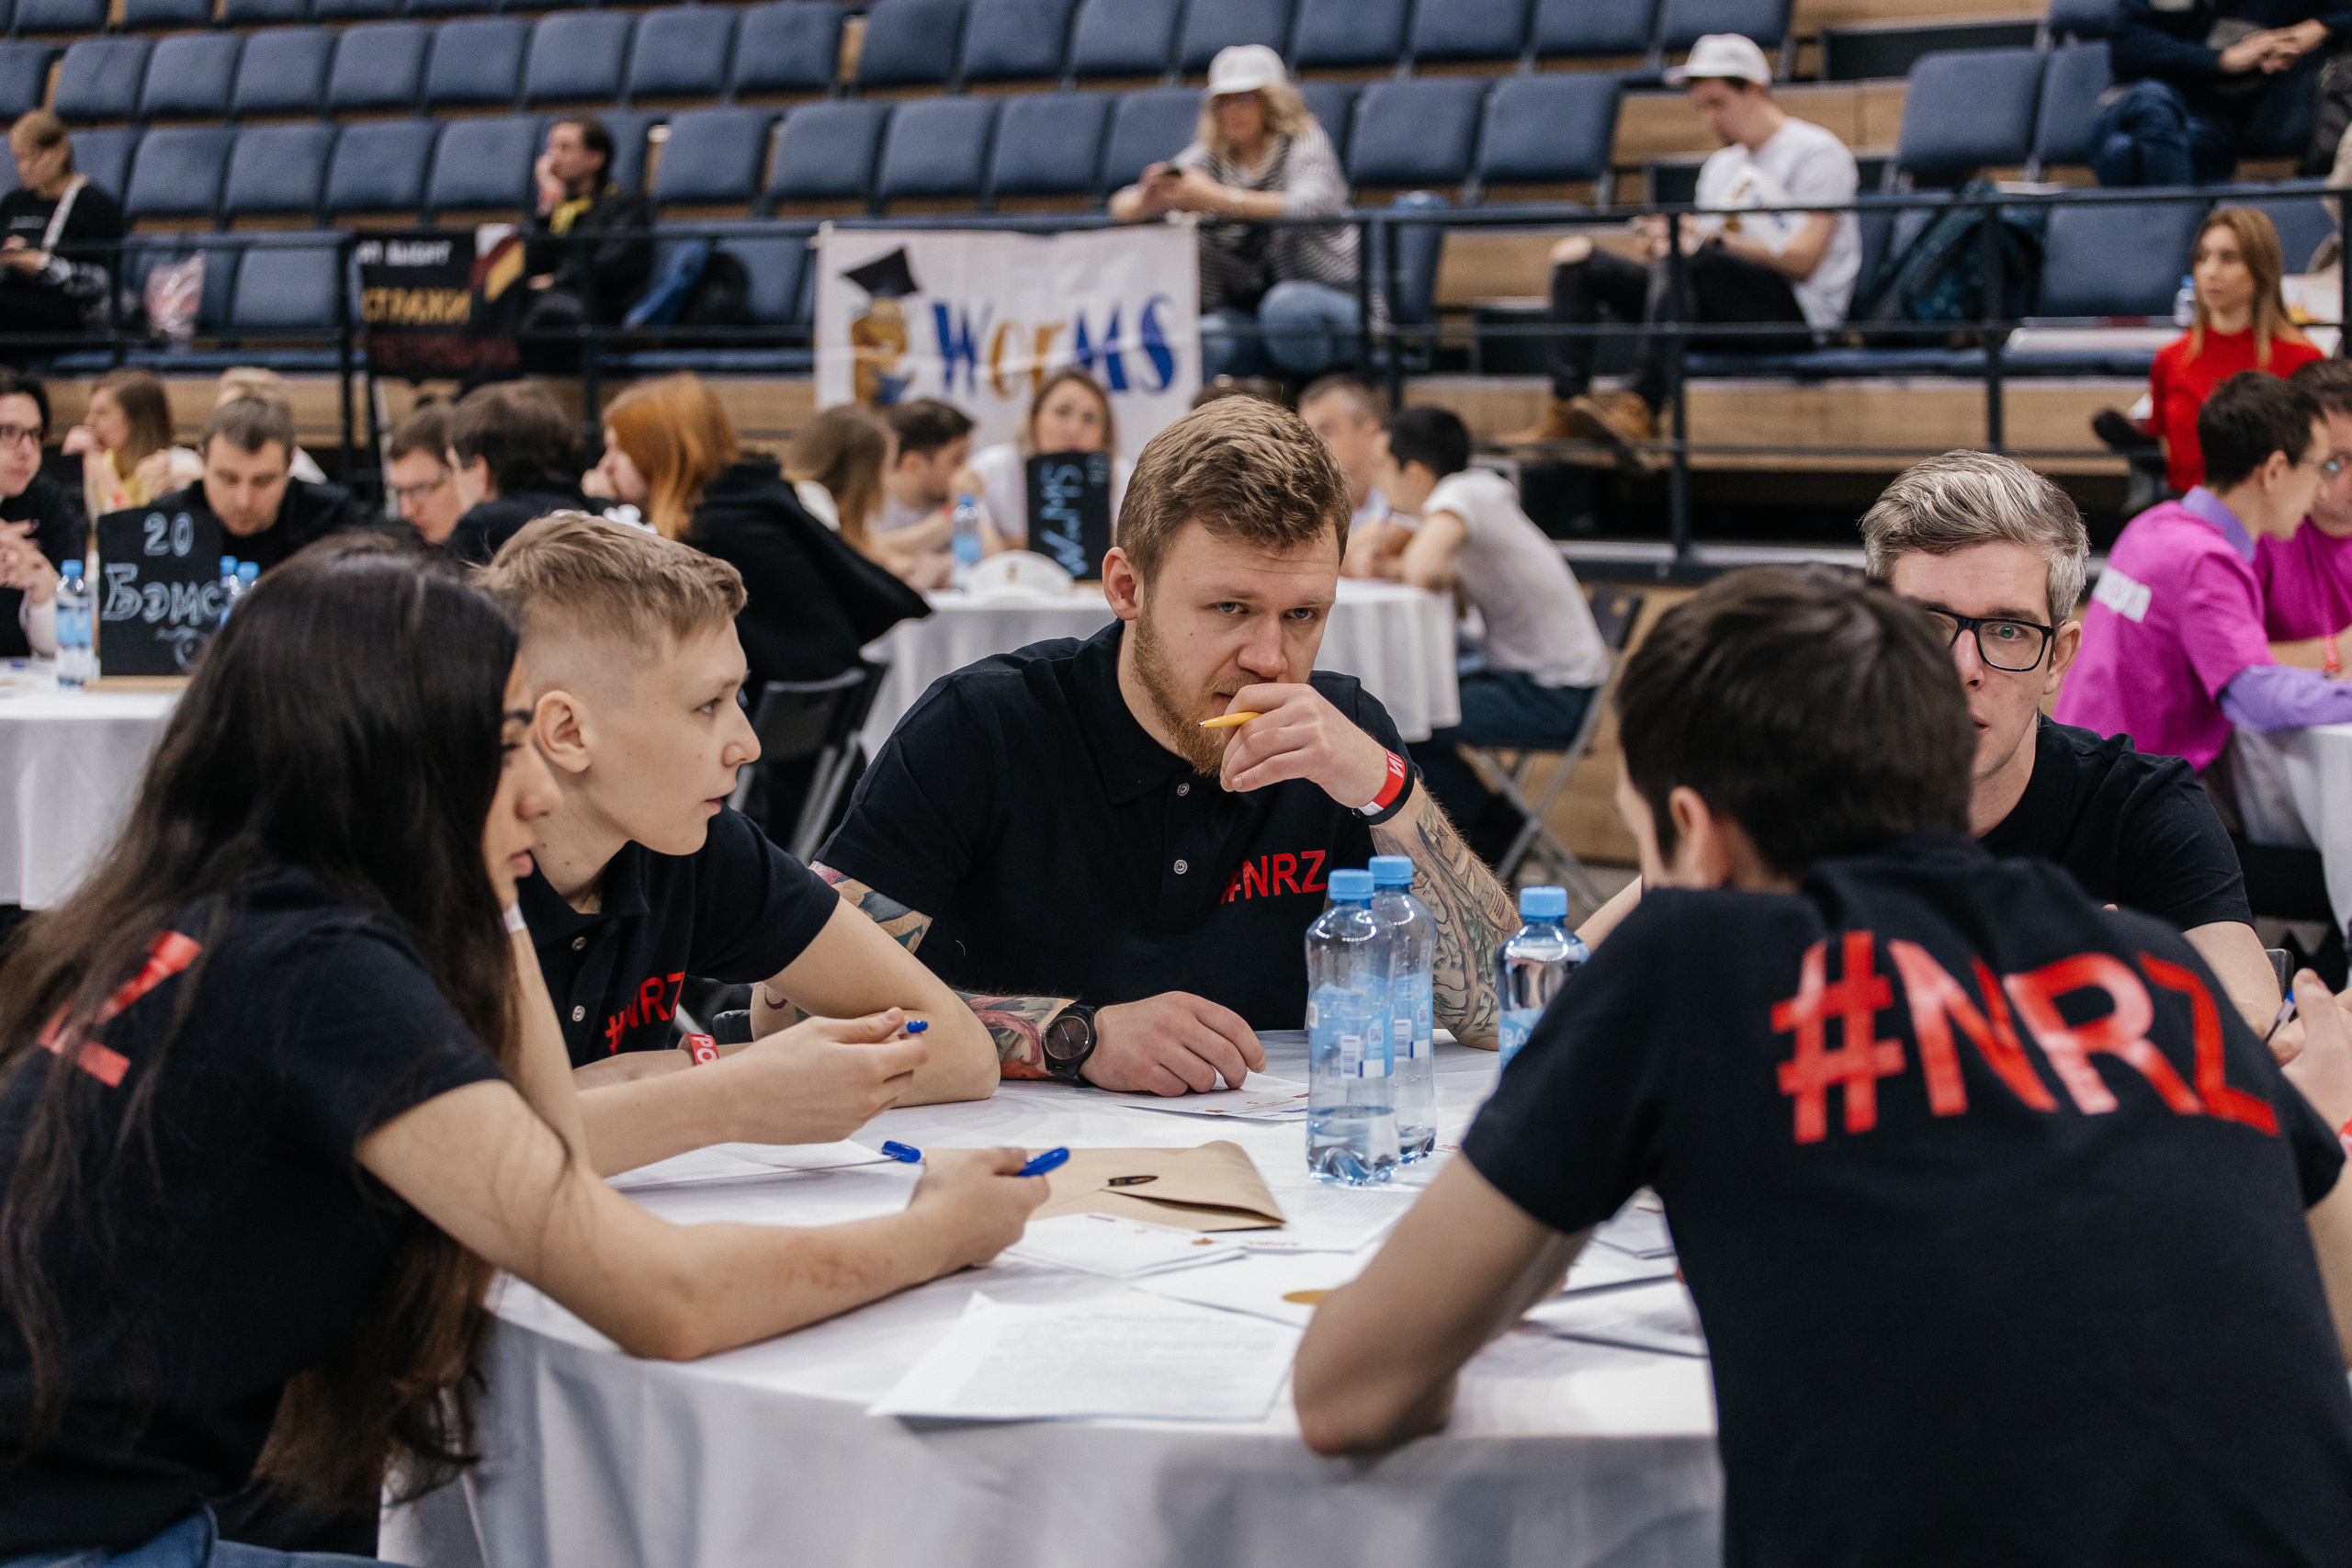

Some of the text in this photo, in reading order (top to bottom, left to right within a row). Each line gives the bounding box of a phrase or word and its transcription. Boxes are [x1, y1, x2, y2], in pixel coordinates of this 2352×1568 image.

[143, 512, 195, 557] 20
[1220, 850, 1327, 904] #NRZ
[1770, 930, 2280, 1145] #NRZ
